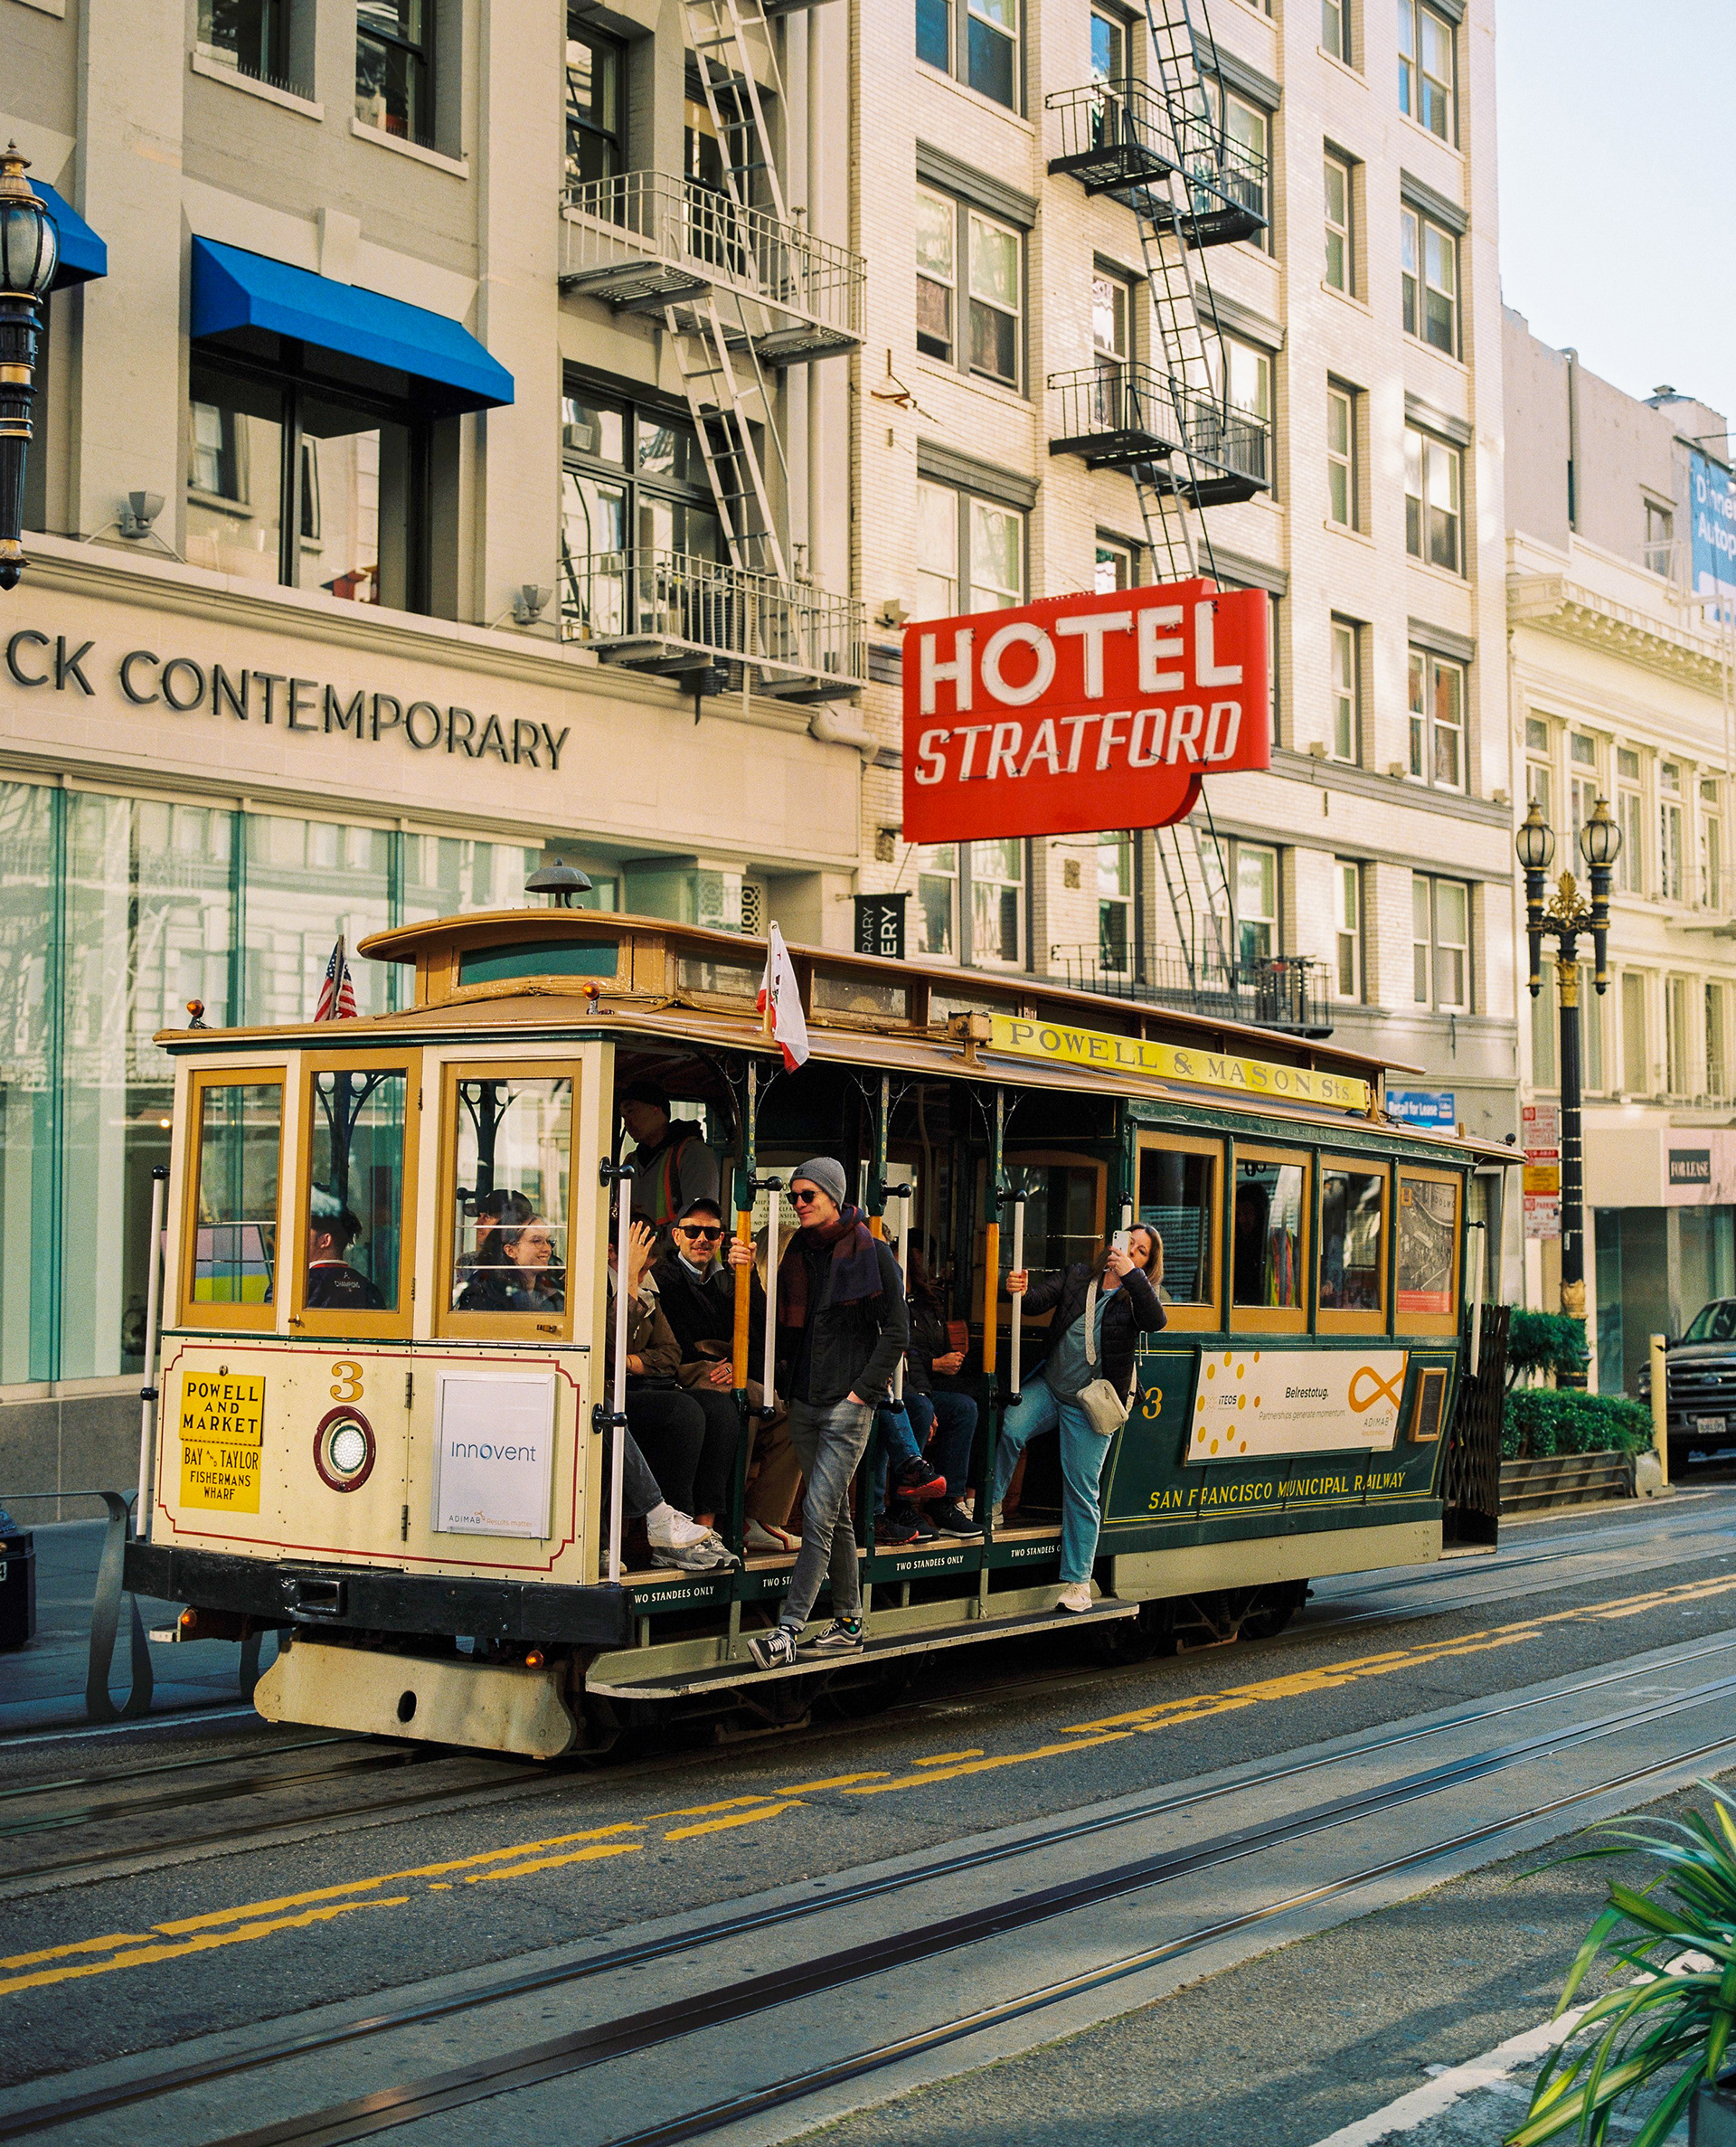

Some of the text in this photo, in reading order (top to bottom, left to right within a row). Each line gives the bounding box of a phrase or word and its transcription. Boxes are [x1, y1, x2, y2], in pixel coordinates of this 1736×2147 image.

[920, 601, 1243, 715] HOTEL
[5, 629, 571, 771] CK CONTEMPORARY
[914, 701, 1242, 785] STRATFORD
[881, 906, 897, 957] ERY
[1009, 1022, 1354, 1102] POWELL & MASON Sts.
[330, 1360, 363, 1403] 3
[187, 1382, 258, 1402] POWELL
[1286, 1386, 1328, 1400] Belrestotug.
[204, 1402, 240, 1414] AND
[1142, 1386, 1163, 1419] 3
[183, 1414, 258, 1433] MARKET
[184, 1447, 259, 1470] BAY AND TAYLOR
[451, 1442, 536, 1461] Innovent
[190, 1471, 250, 1487] FISHERMANS
[204, 1486, 235, 1500] WHARF
[1148, 1472, 1406, 1509] SAN FRANCISCO MUNICIPAL RAILWAY
[448, 1515, 480, 1524] ADIMAB
[1011, 1549, 1024, 1558] TWO
[1026, 1546, 1055, 1556] STANDEES
[896, 1555, 964, 1571] TWO STANDEES ONLY
[762, 1577, 779, 1588] TWO
[634, 1585, 714, 1603] WO STANDEES ONLY
